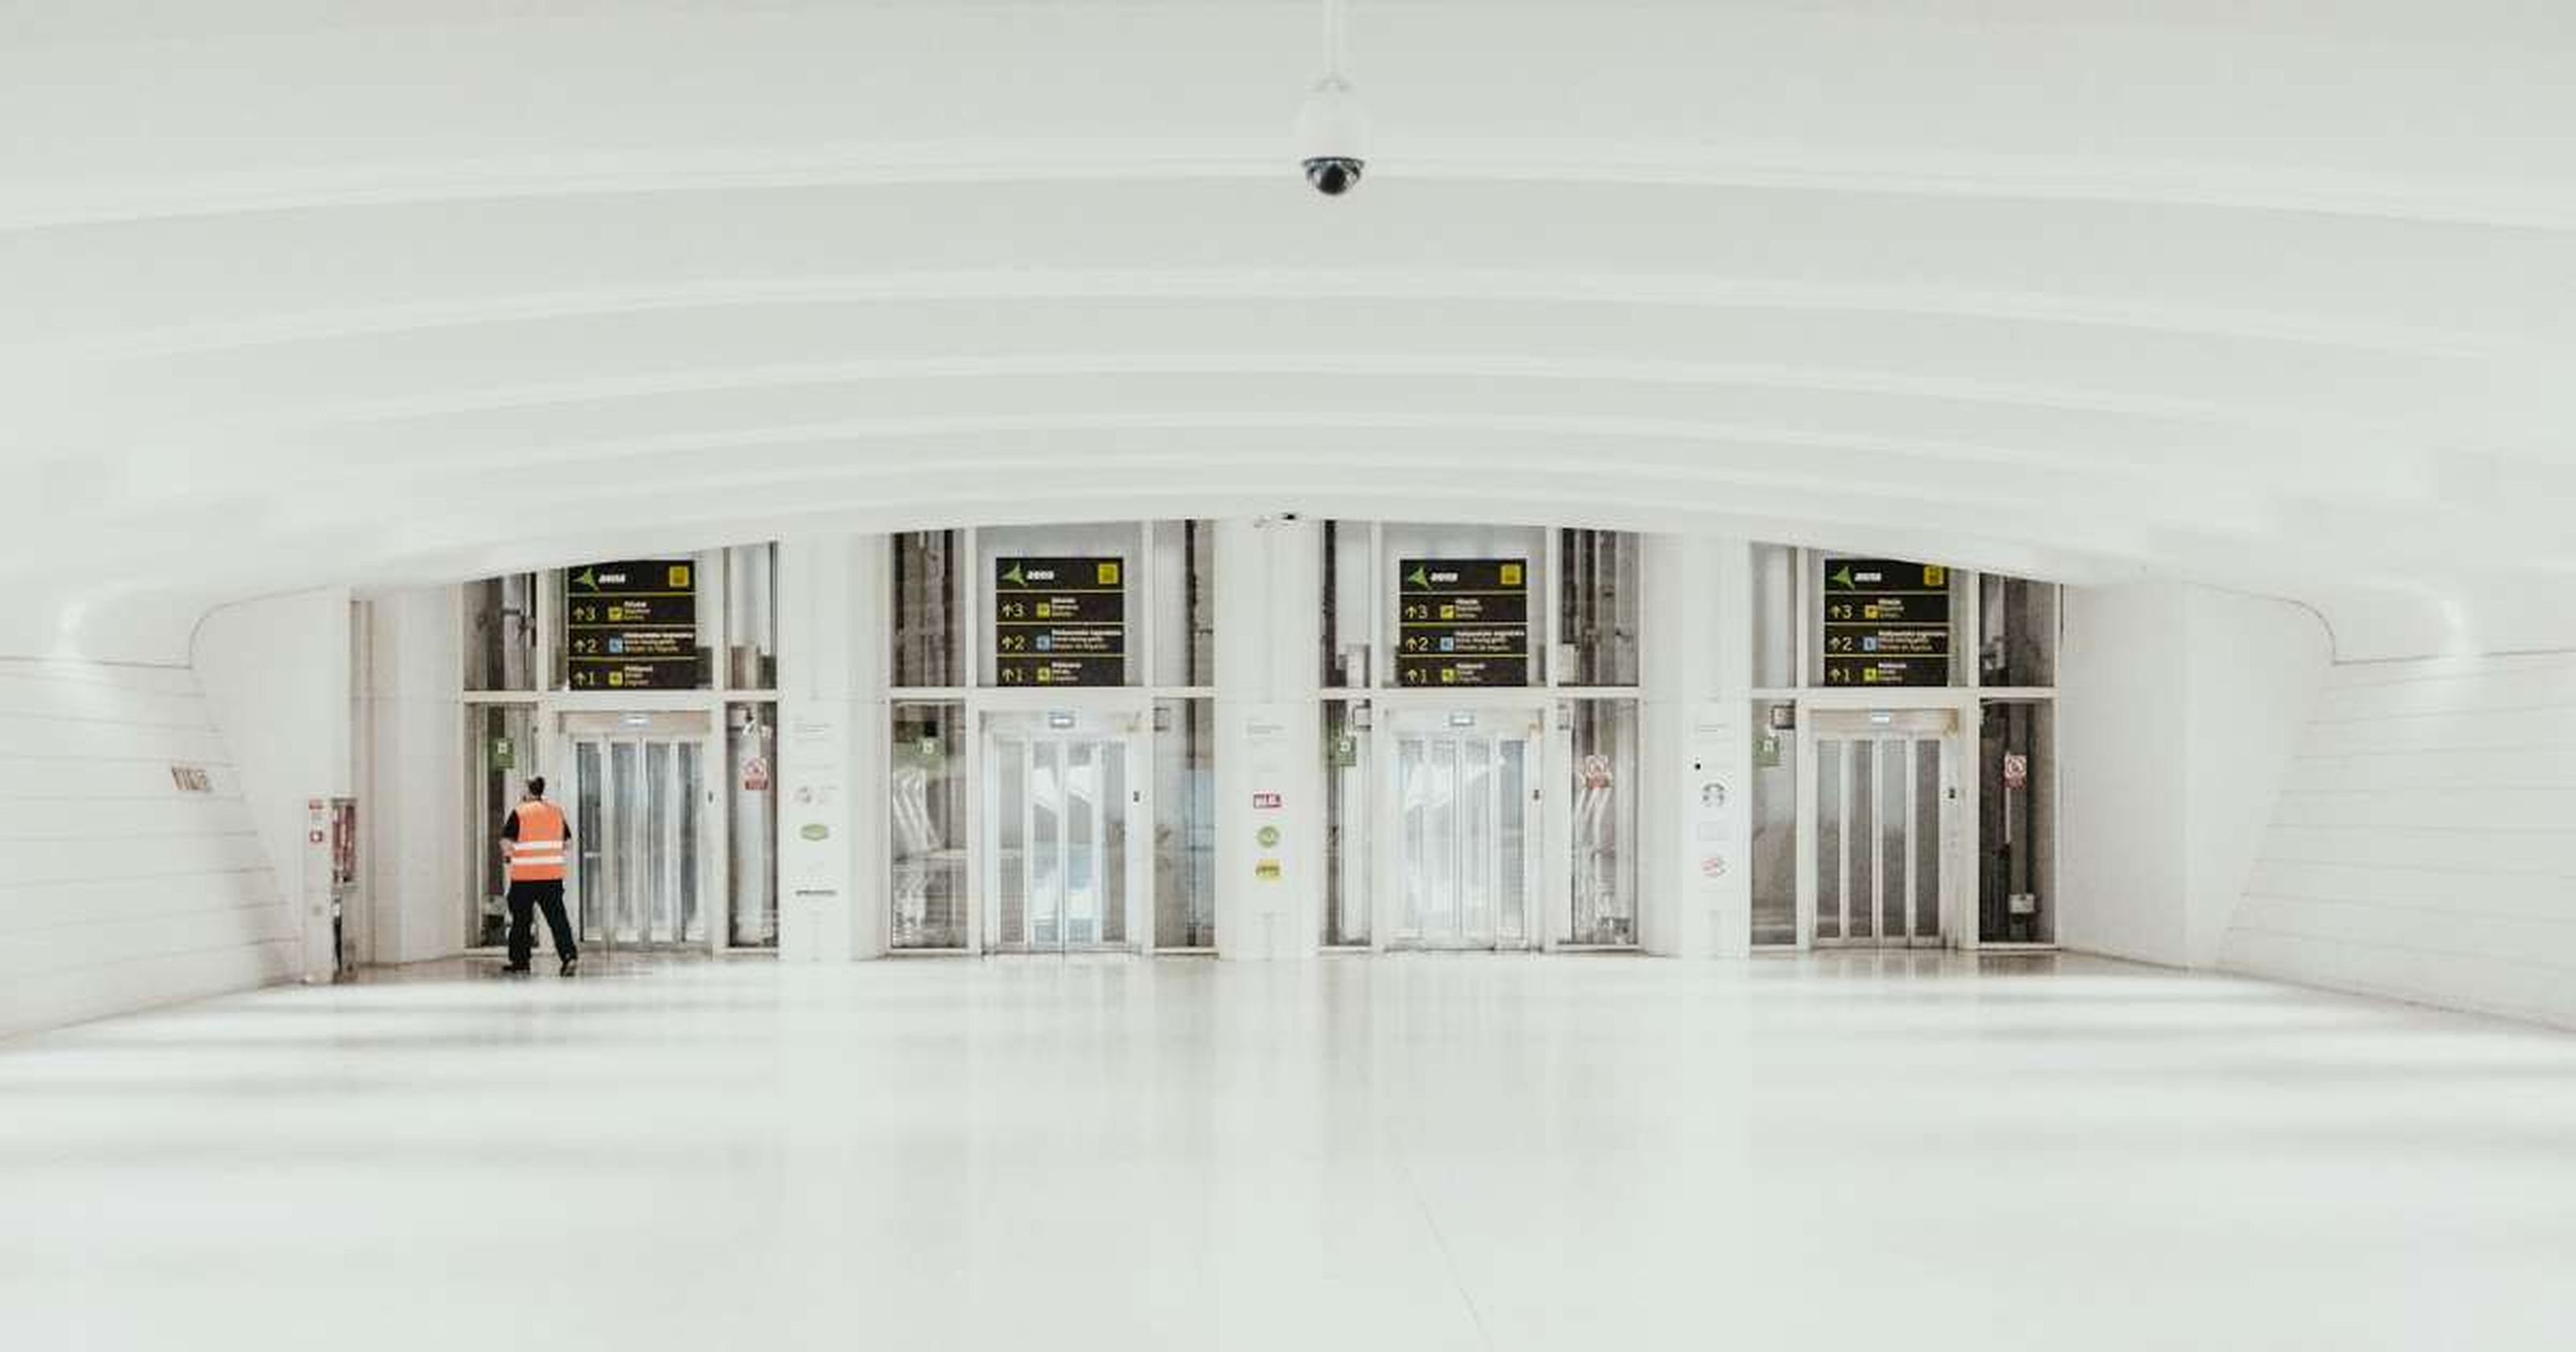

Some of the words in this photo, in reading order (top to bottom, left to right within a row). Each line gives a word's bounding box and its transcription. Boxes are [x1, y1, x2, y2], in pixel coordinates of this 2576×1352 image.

[585, 607, 596, 620] 3
[1014, 603, 1024, 617] 3
[1418, 604, 1428, 619] 3
[1842, 604, 1852, 619] 3
[588, 639, 597, 653] 2
[1014, 635, 1025, 650] 2
[1418, 637, 1429, 651] 2
[1843, 637, 1852, 651] 2
